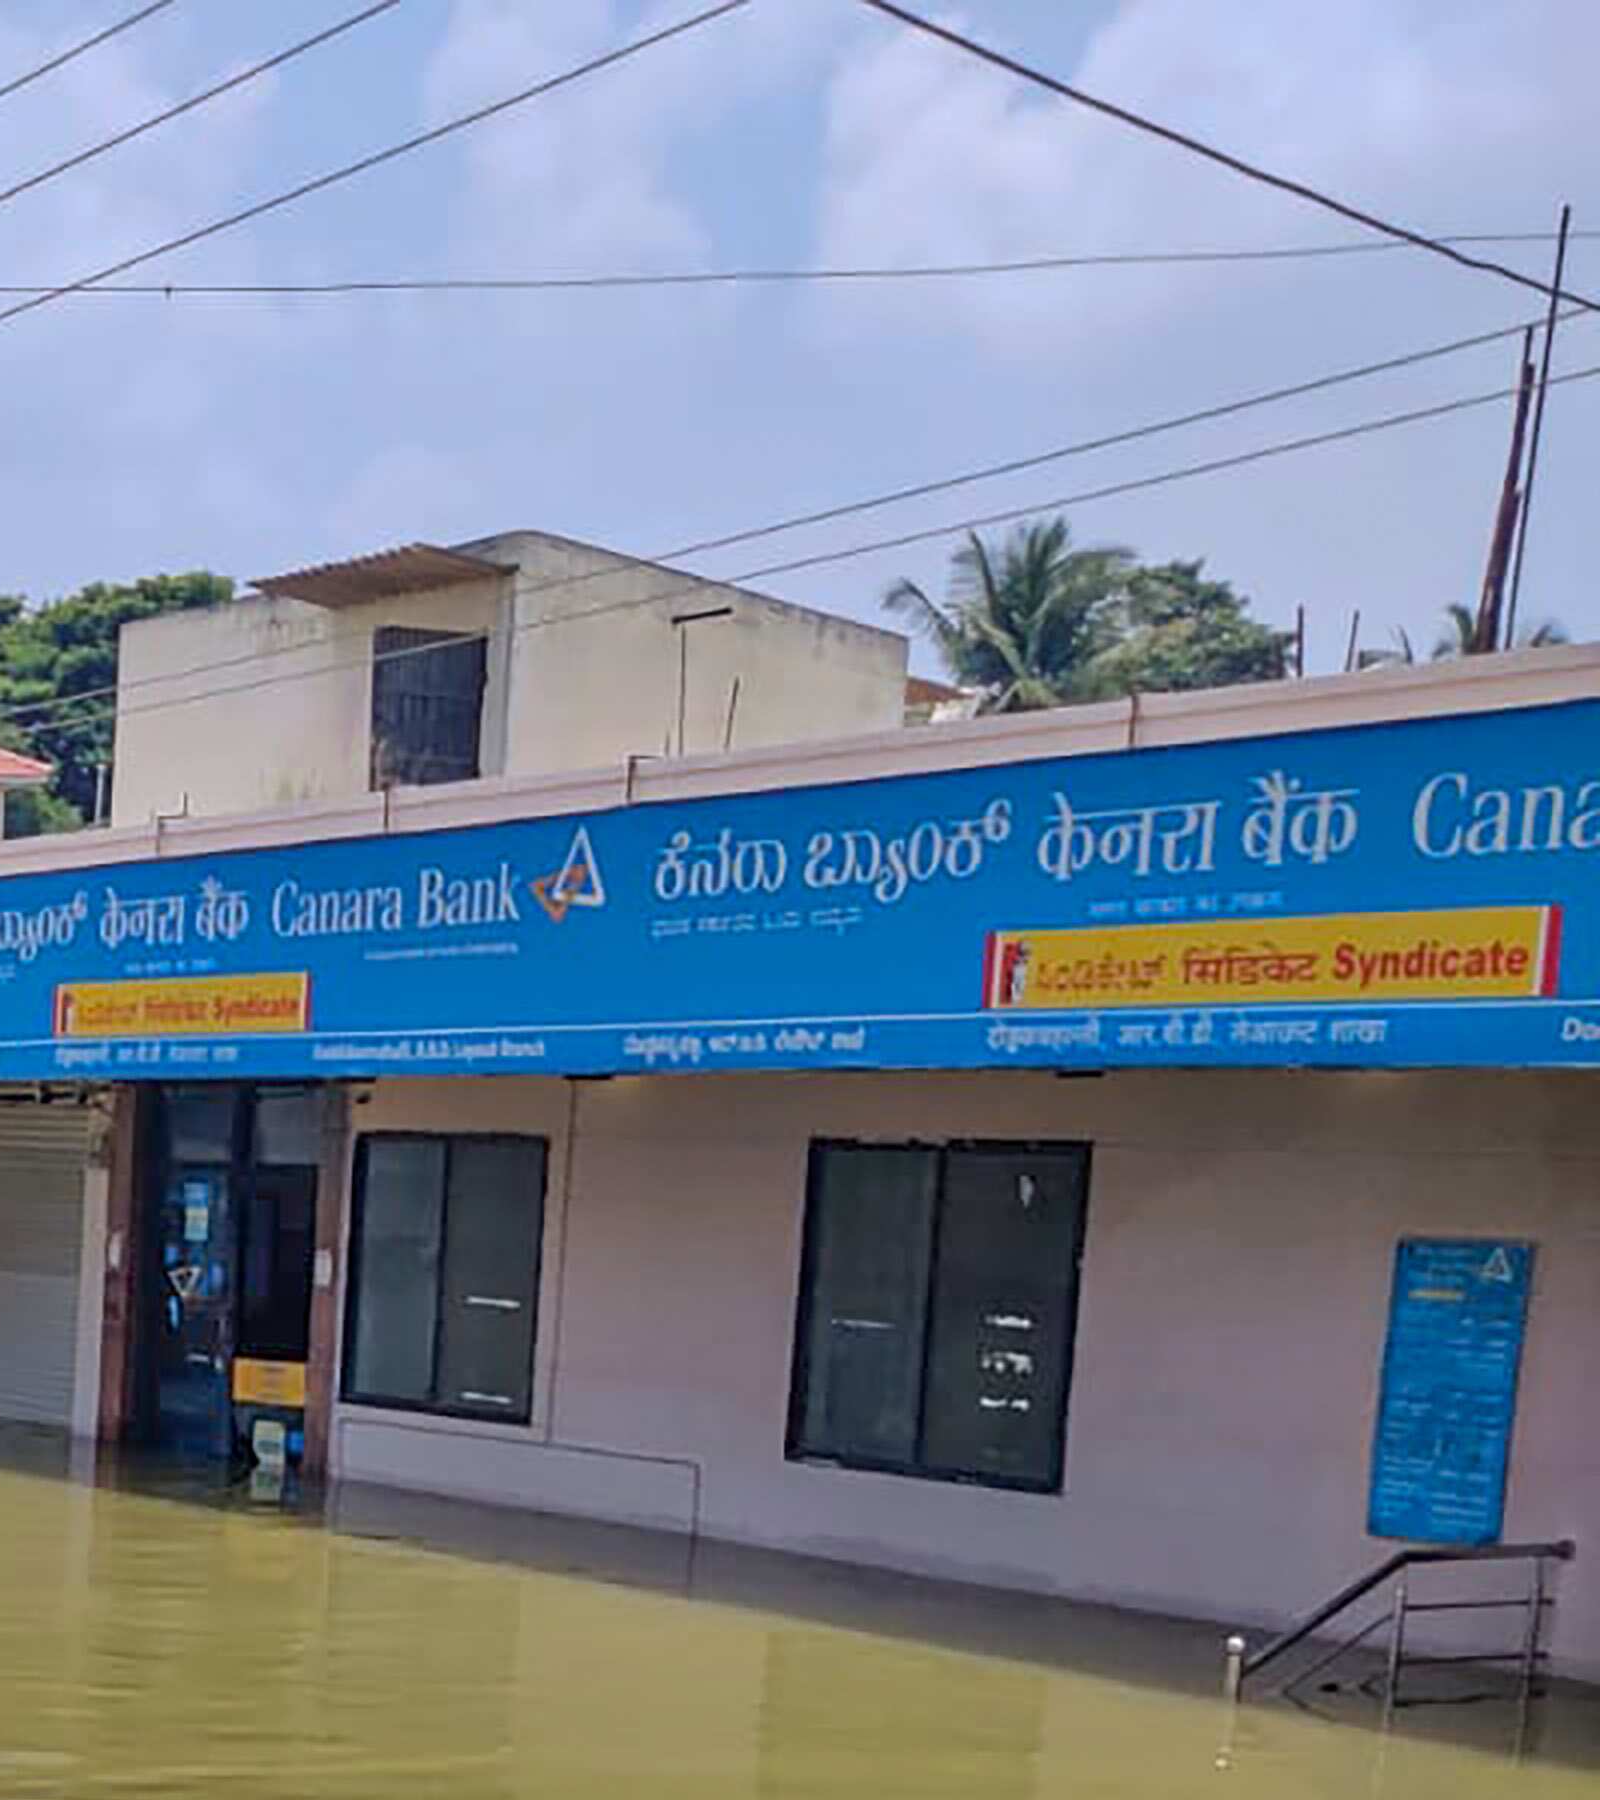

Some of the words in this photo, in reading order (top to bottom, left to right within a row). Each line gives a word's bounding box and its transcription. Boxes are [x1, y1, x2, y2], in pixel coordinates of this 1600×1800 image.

[1038, 793, 1221, 879] केनरा
[1241, 771, 1360, 866] बैंक
[100, 887, 186, 949] केनरा
[196, 876, 249, 942] बैंक
[272, 880, 402, 937] Canara
[417, 862, 521, 928] Bank
[1333, 942, 1528, 990] Syndicate
